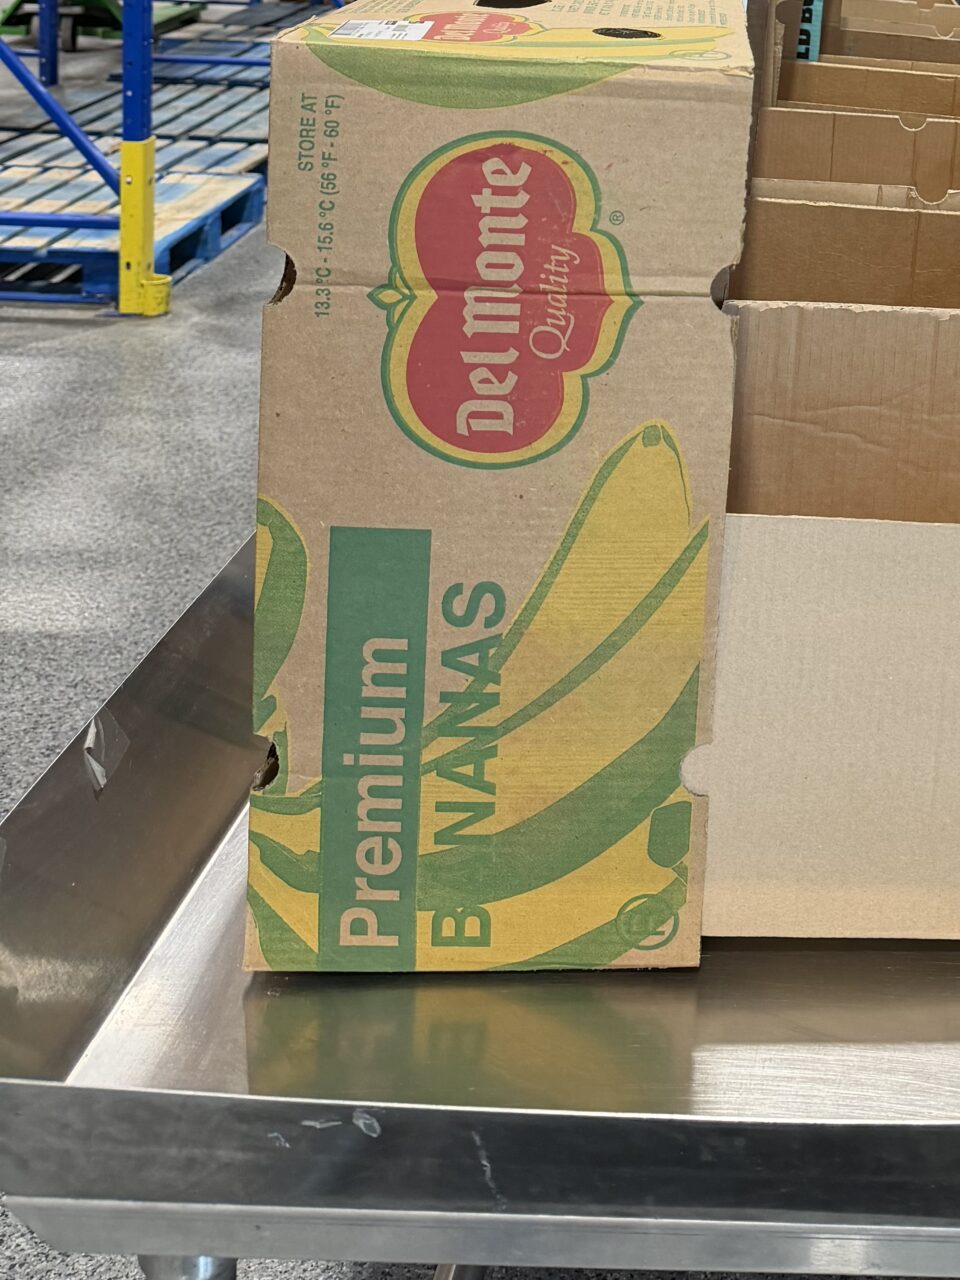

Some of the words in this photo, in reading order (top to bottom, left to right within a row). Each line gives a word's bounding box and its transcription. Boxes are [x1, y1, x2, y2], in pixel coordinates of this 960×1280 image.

[301, 92, 318, 113] AT
[324, 119, 340, 138] 60
[298, 117, 316, 172] STORE
[320, 172, 340, 196] (56
[317, 222, 334, 253] 15.6
[462, 157, 532, 339] Monte
[315, 287, 331, 318] 13.3
[529, 244, 581, 360] Quality
[456, 347, 520, 437] Del
[339, 636, 409, 948] Premium
[431, 580, 507, 949] BNANAS
